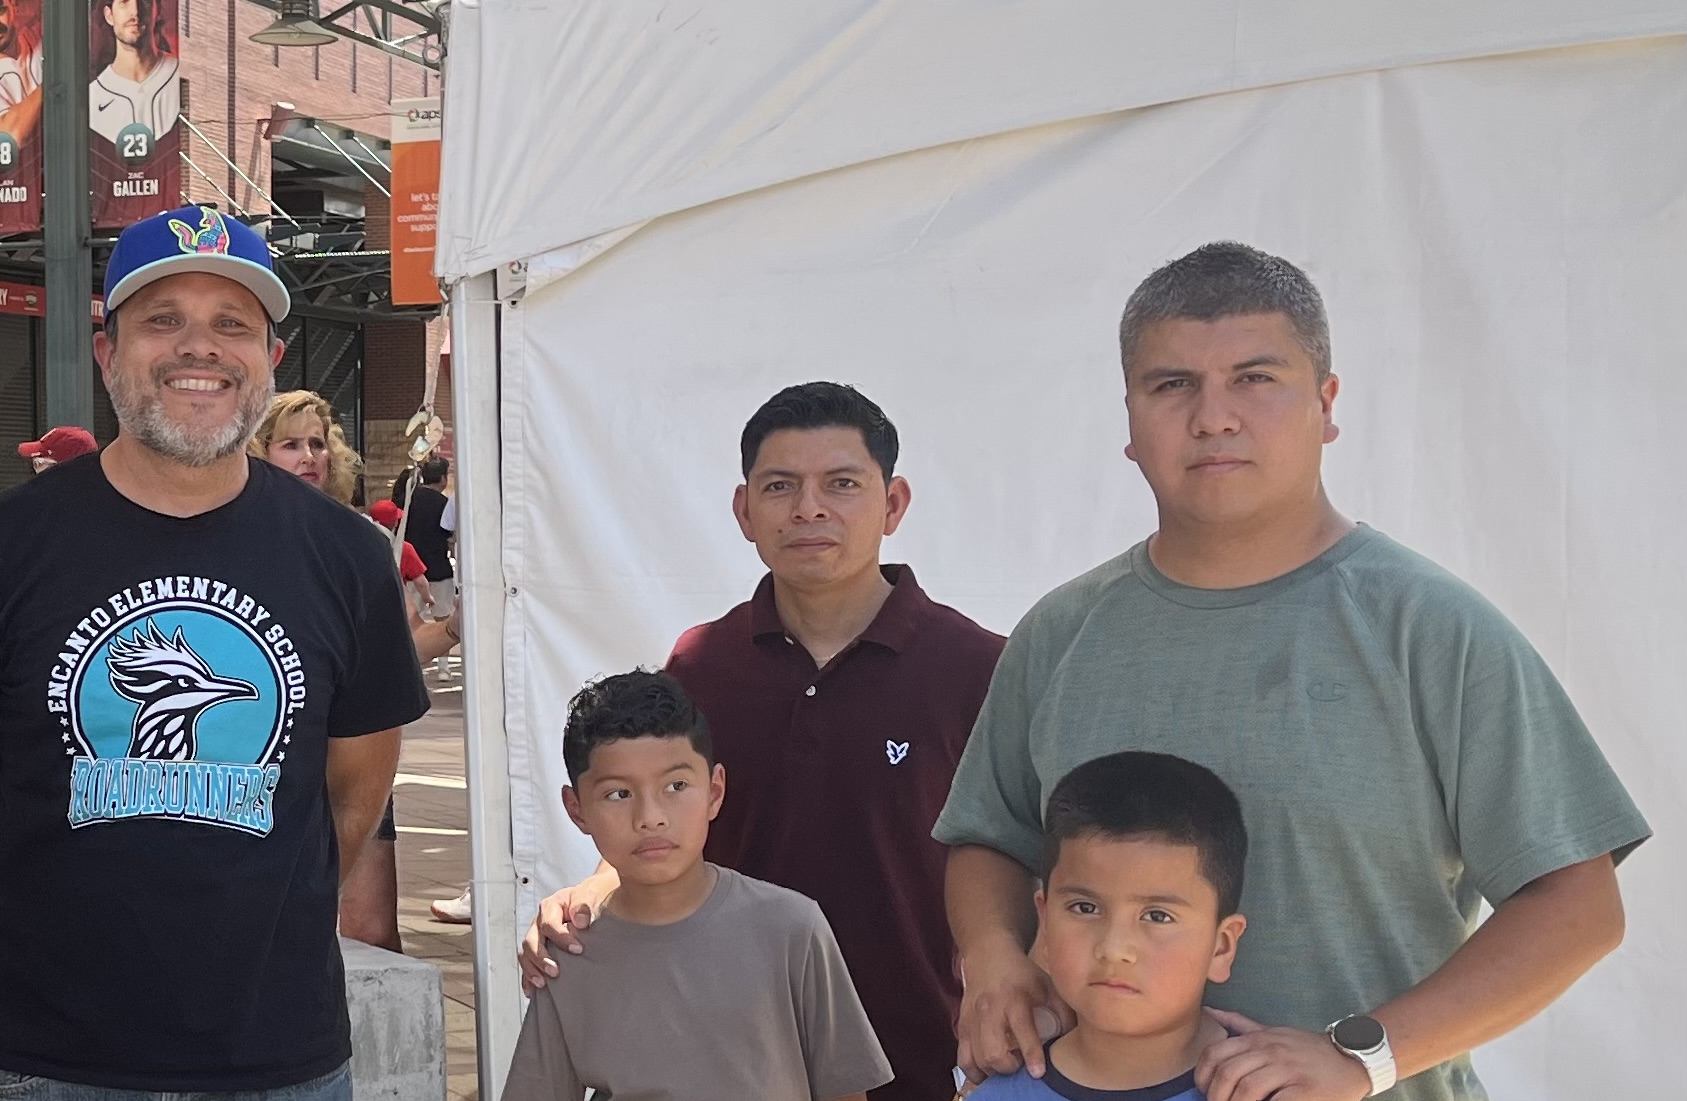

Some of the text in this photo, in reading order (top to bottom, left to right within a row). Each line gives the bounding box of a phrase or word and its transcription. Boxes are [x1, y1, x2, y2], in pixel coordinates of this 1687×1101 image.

[123, 134, 148, 158] 23
[128, 172, 145, 180] ZAC
[113, 179, 159, 198] GALLEN
[47, 574, 307, 715] ENCANTO ELEMENTARY SCHOOL
[68, 755, 281, 838] ROADRUNNERS
